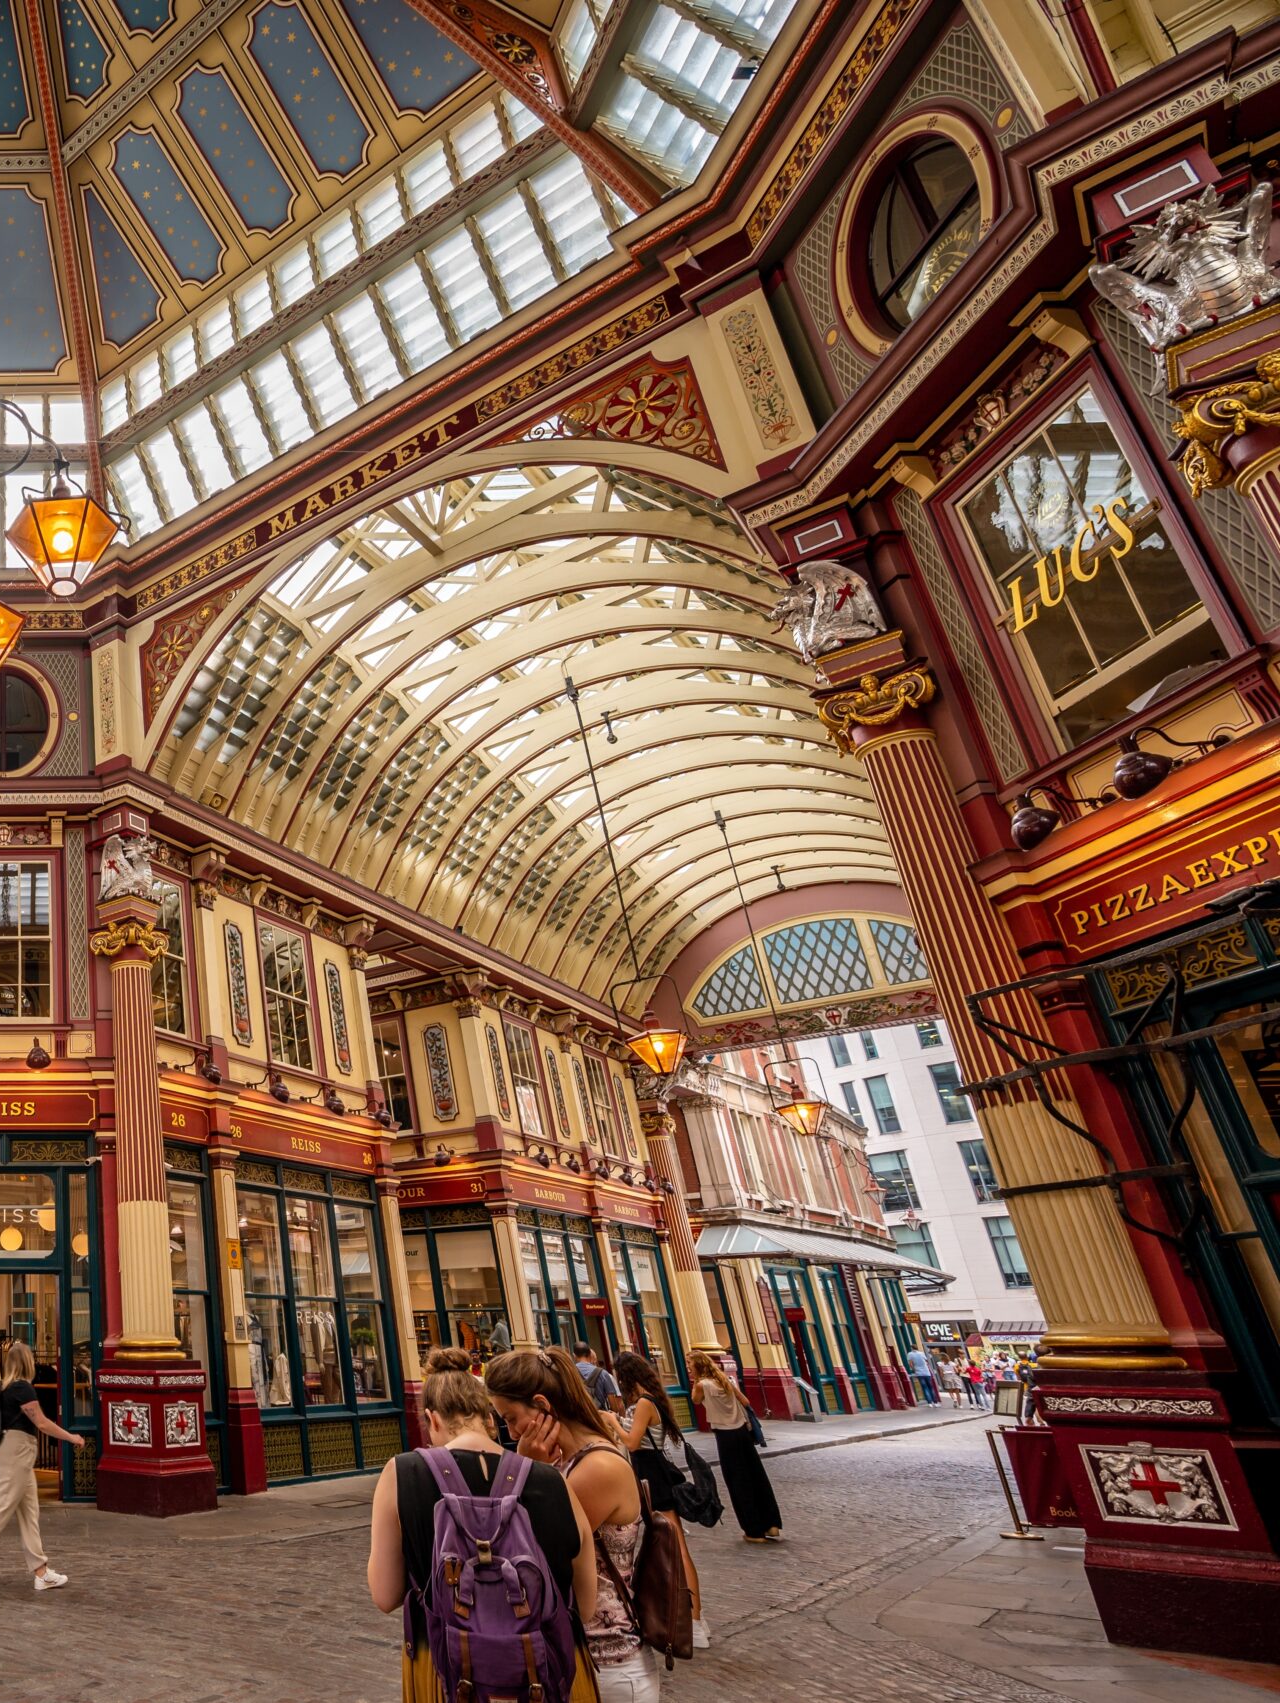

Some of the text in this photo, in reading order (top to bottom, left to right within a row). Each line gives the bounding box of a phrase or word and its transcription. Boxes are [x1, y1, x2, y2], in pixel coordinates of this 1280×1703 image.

[1007, 496, 1133, 634] LUC'S
[171, 1112, 186, 1127] 26
[230, 1125, 373, 1165] 26 REISS 26
[470, 1183, 483, 1194] 31
[534, 1187, 567, 1203] BARBOUR
[613, 1204, 640, 1218] BARBOUR
[296, 1311, 334, 1325] REISS
[925, 1323, 952, 1336] LOVE
